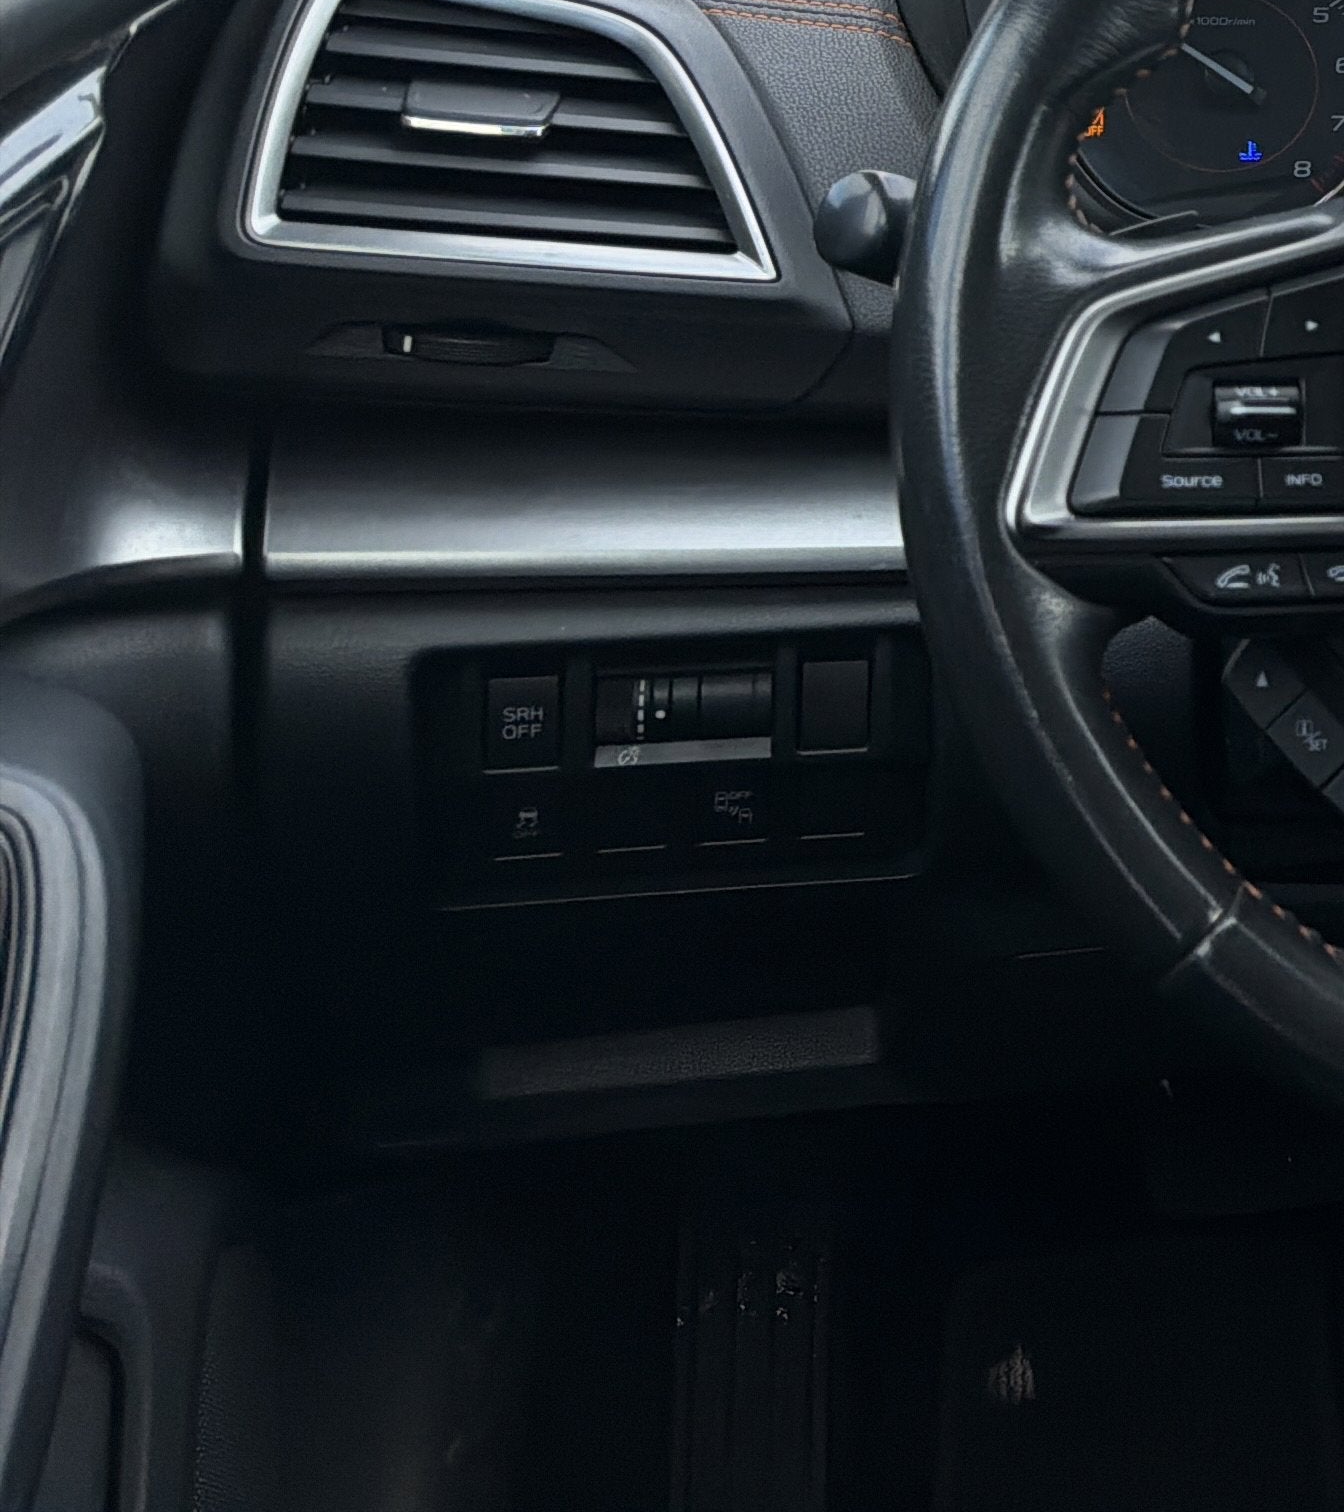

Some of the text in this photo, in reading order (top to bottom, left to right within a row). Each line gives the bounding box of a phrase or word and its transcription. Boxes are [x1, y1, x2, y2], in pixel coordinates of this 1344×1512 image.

[1312, 6, 1330, 24] 5
[1293, 160, 1312, 178] 8
[1160, 474, 1223, 488] Source
[1285, 472, 1323, 487] INFO
[502, 706, 544, 723] SRH
[502, 723, 543, 740] OFF
